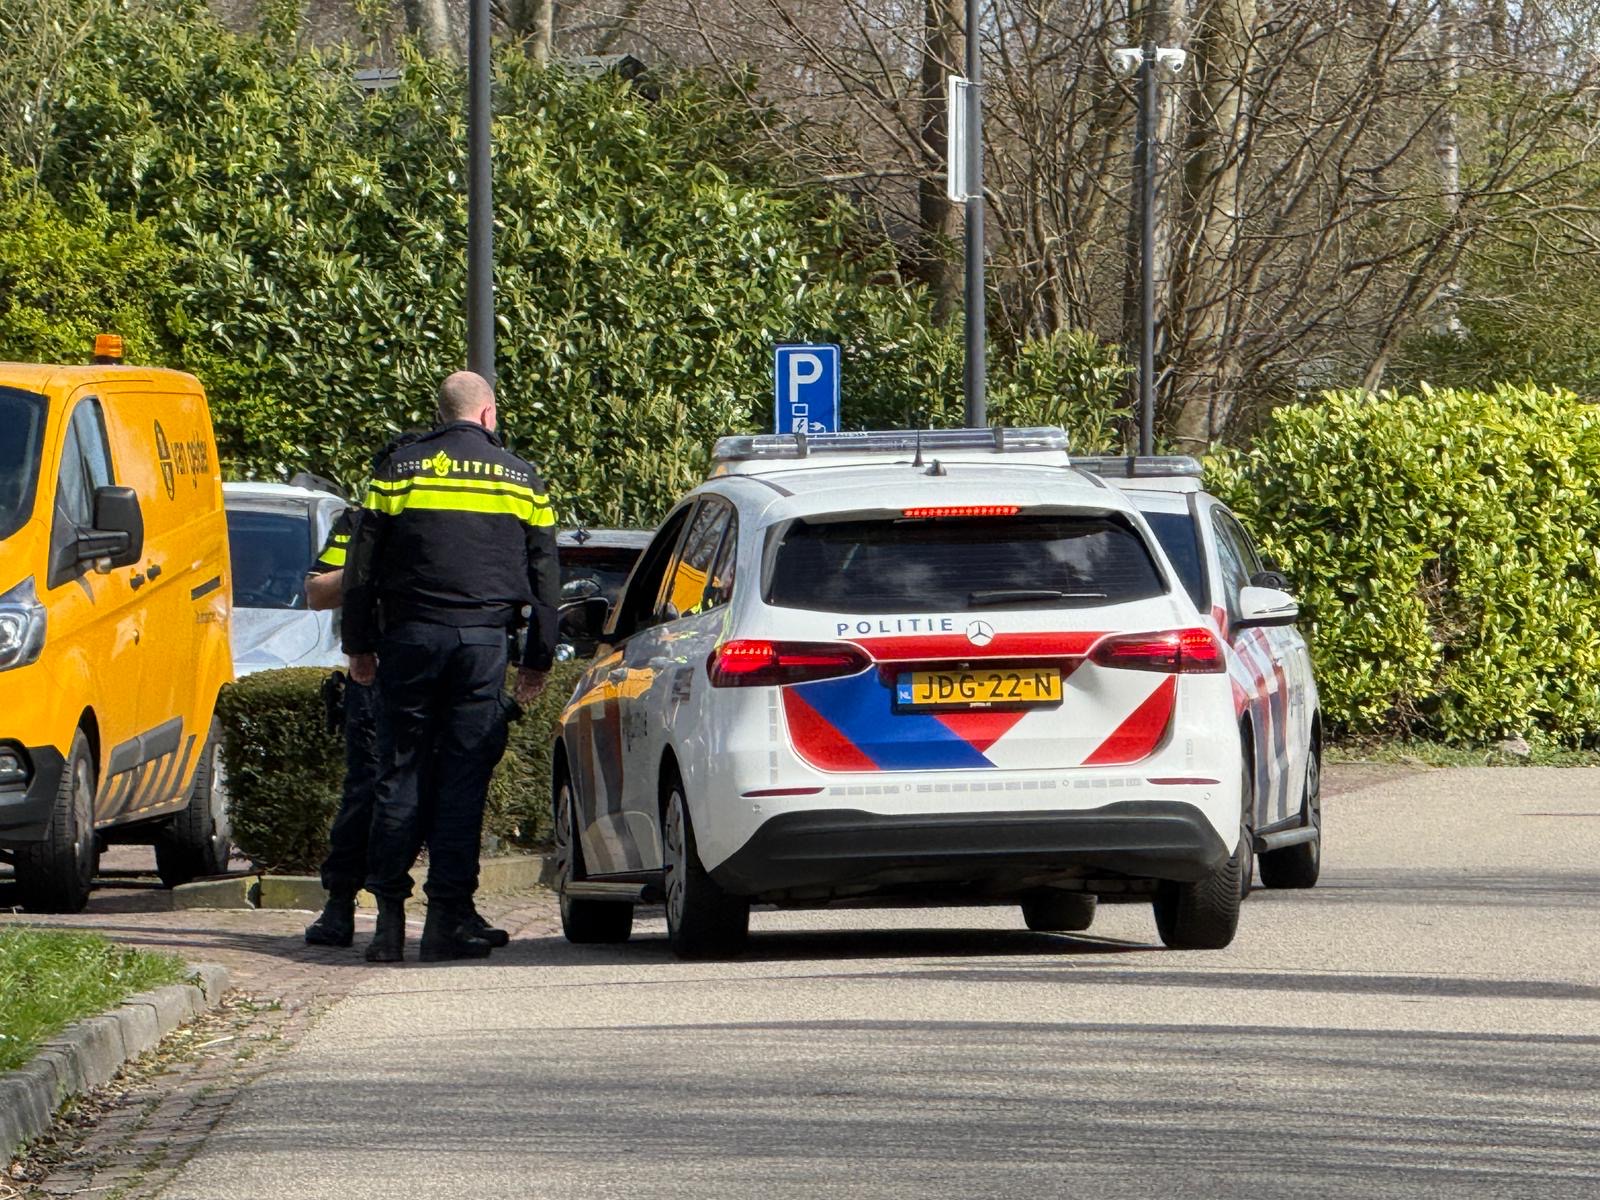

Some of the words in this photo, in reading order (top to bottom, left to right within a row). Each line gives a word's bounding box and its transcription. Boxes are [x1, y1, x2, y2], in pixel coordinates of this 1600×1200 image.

[789, 353, 823, 402] P
[836, 618, 953, 636] POLITIE
[922, 672, 1052, 700] JDG-22-N
